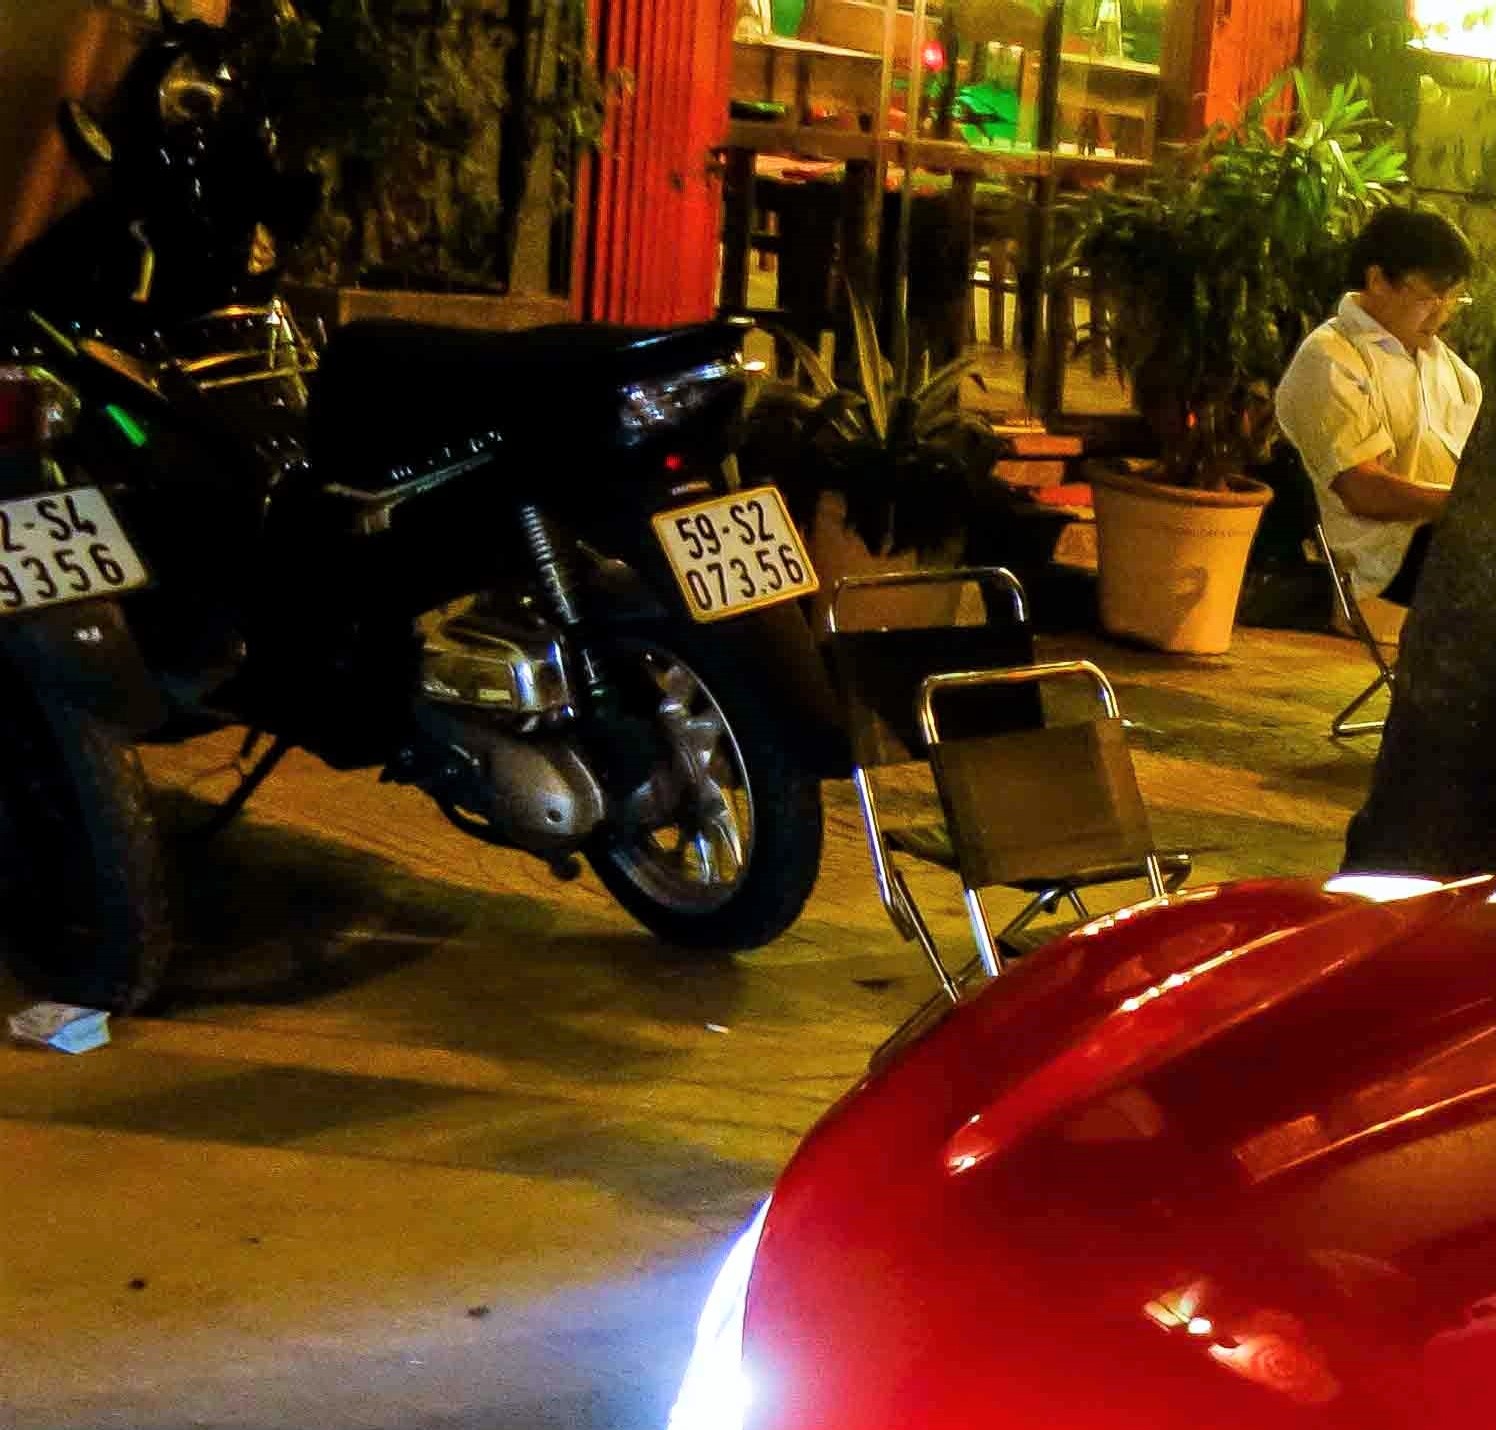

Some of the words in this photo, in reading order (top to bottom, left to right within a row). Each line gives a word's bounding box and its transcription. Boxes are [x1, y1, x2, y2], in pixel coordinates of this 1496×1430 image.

[674, 500, 775, 560] 59-S2
[0, 543, 125, 607] 9356
[685, 544, 804, 611] 073.56
